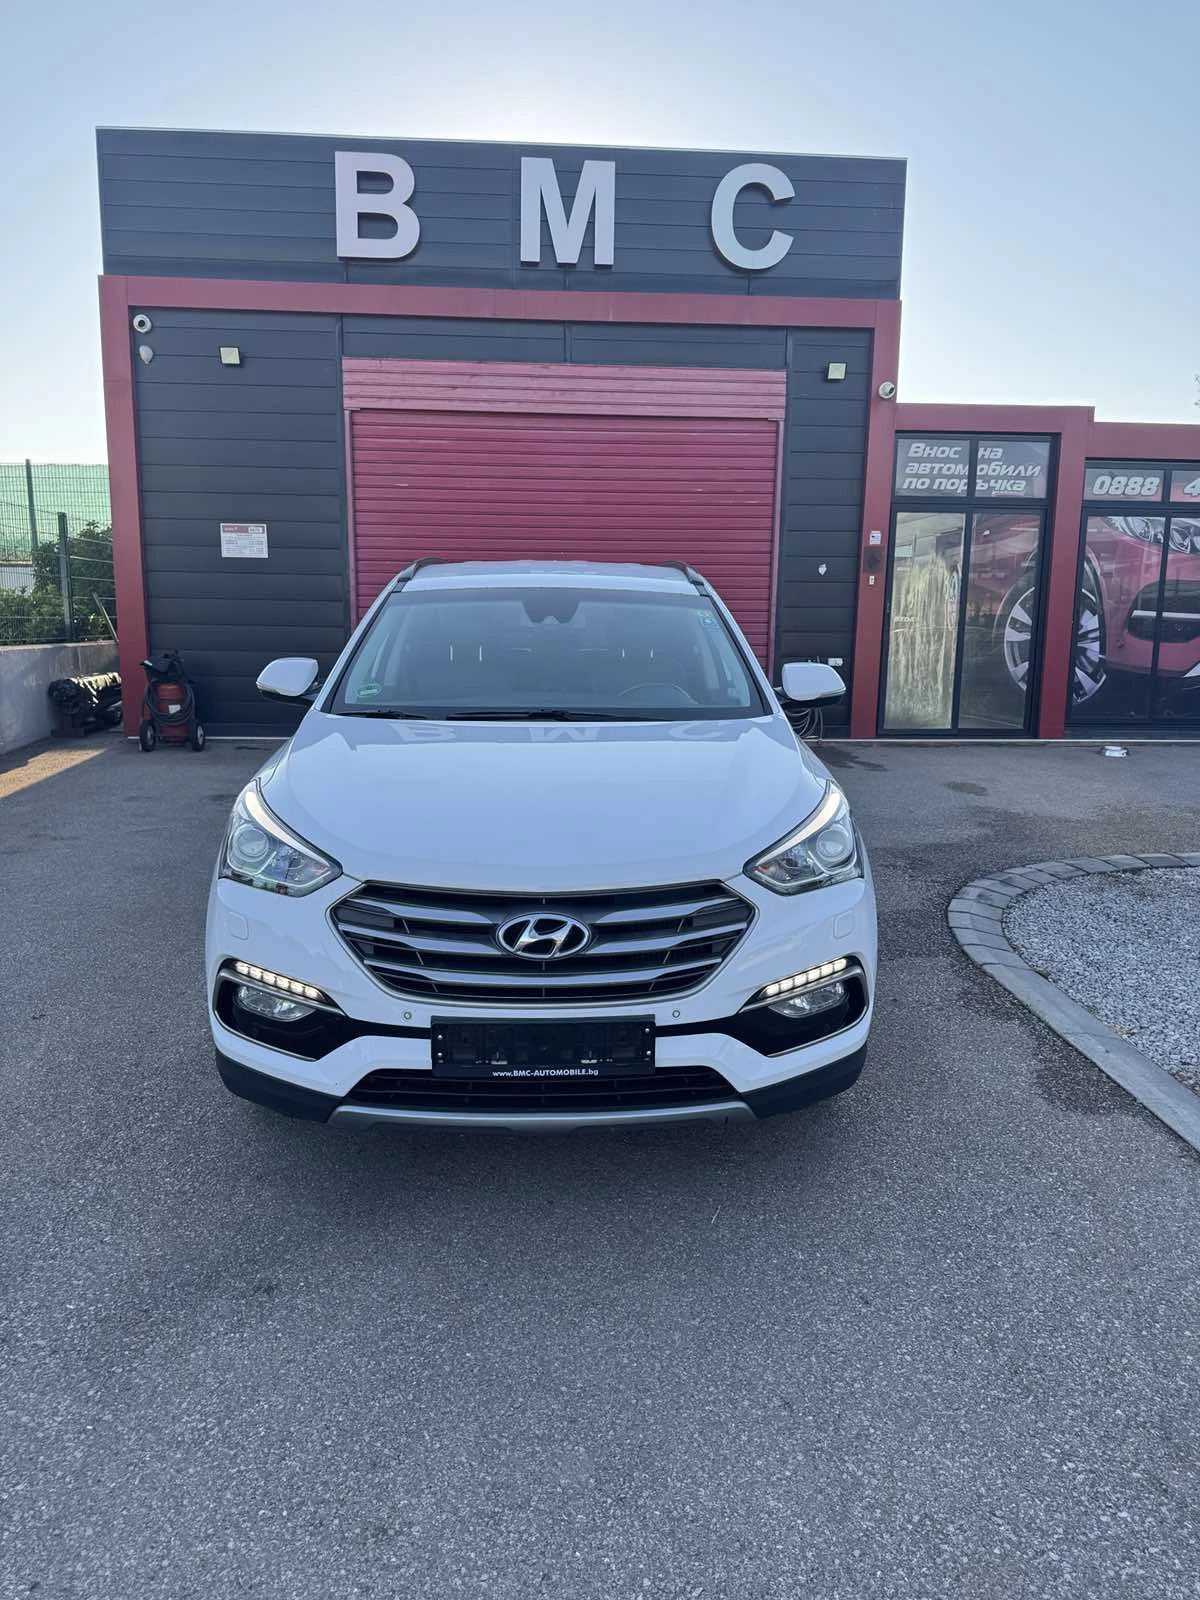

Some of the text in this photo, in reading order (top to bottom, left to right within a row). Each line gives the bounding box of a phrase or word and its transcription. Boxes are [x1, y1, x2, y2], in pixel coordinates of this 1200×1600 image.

[334, 150, 796, 271] B M C
[907, 442, 1004, 459] Внос на
[904, 461, 1041, 477] автомобили
[902, 477, 930, 490] по
[1092, 475, 1160, 496] 0888
[492, 1068, 599, 1077] www.BMC-AUTOMOBILE.bg
